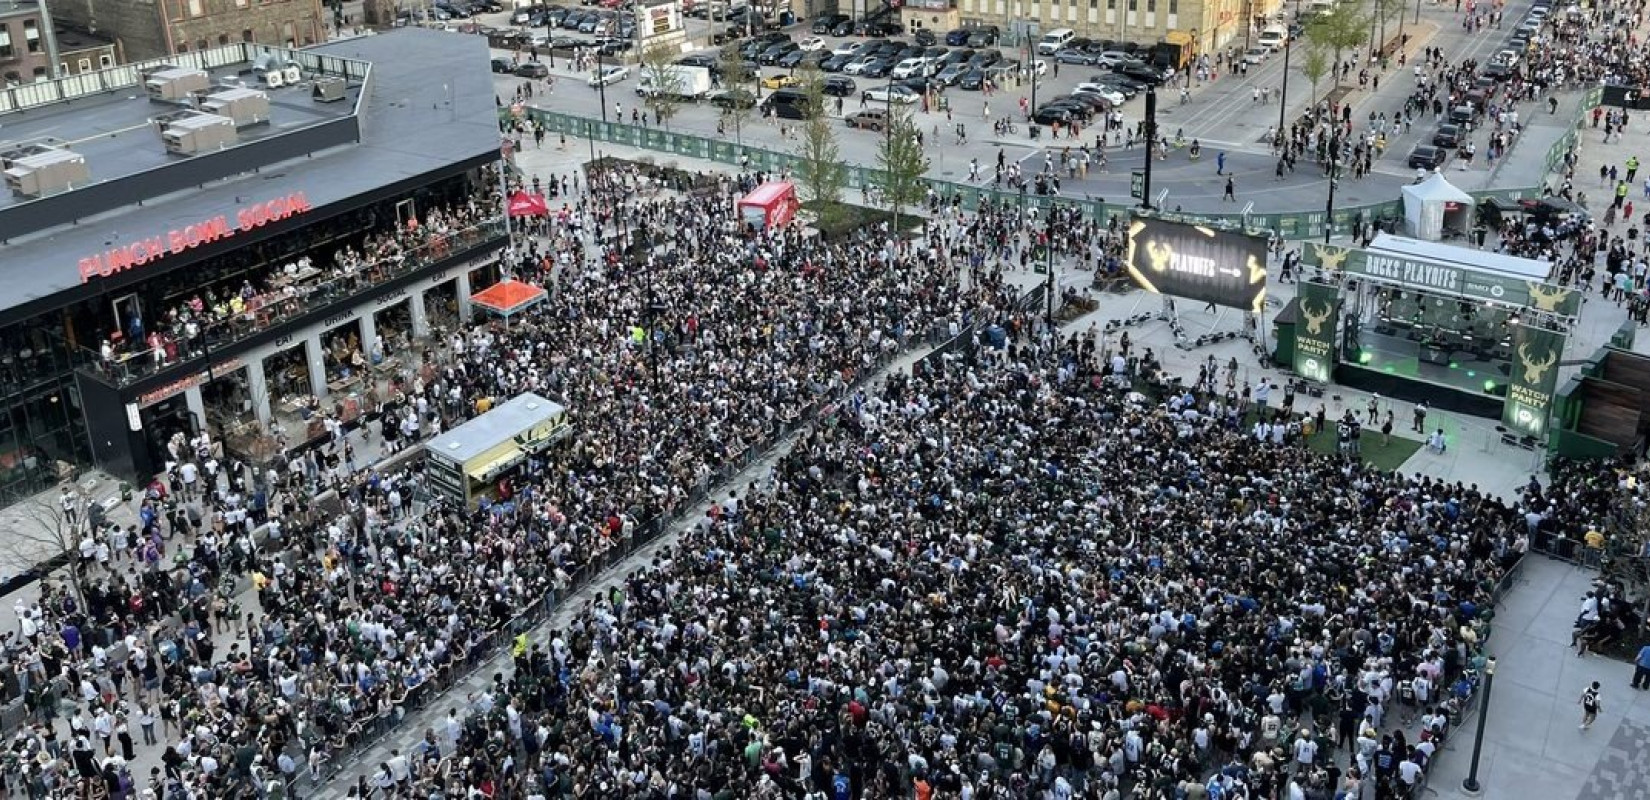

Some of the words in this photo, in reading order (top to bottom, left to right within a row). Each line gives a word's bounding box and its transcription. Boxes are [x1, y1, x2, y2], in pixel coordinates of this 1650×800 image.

[79, 234, 165, 284] PUNCH
[168, 215, 234, 254] BOWL
[237, 191, 312, 231] SOCIAL
[1170, 252, 1216, 277] PLAYOFFS
[1365, 254, 1400, 279] BUCKS
[1403, 262, 1457, 290] PLAYOFFS
[376, 288, 406, 305] SOCIAL
[324, 309, 355, 327] DRINK
[275, 334, 293, 347] EAT
[1297, 336, 1330, 350] WATCH
[1297, 343, 1328, 356] PARTY
[1511, 383, 1550, 402] WATCH
[1511, 391, 1546, 408] PARTY
